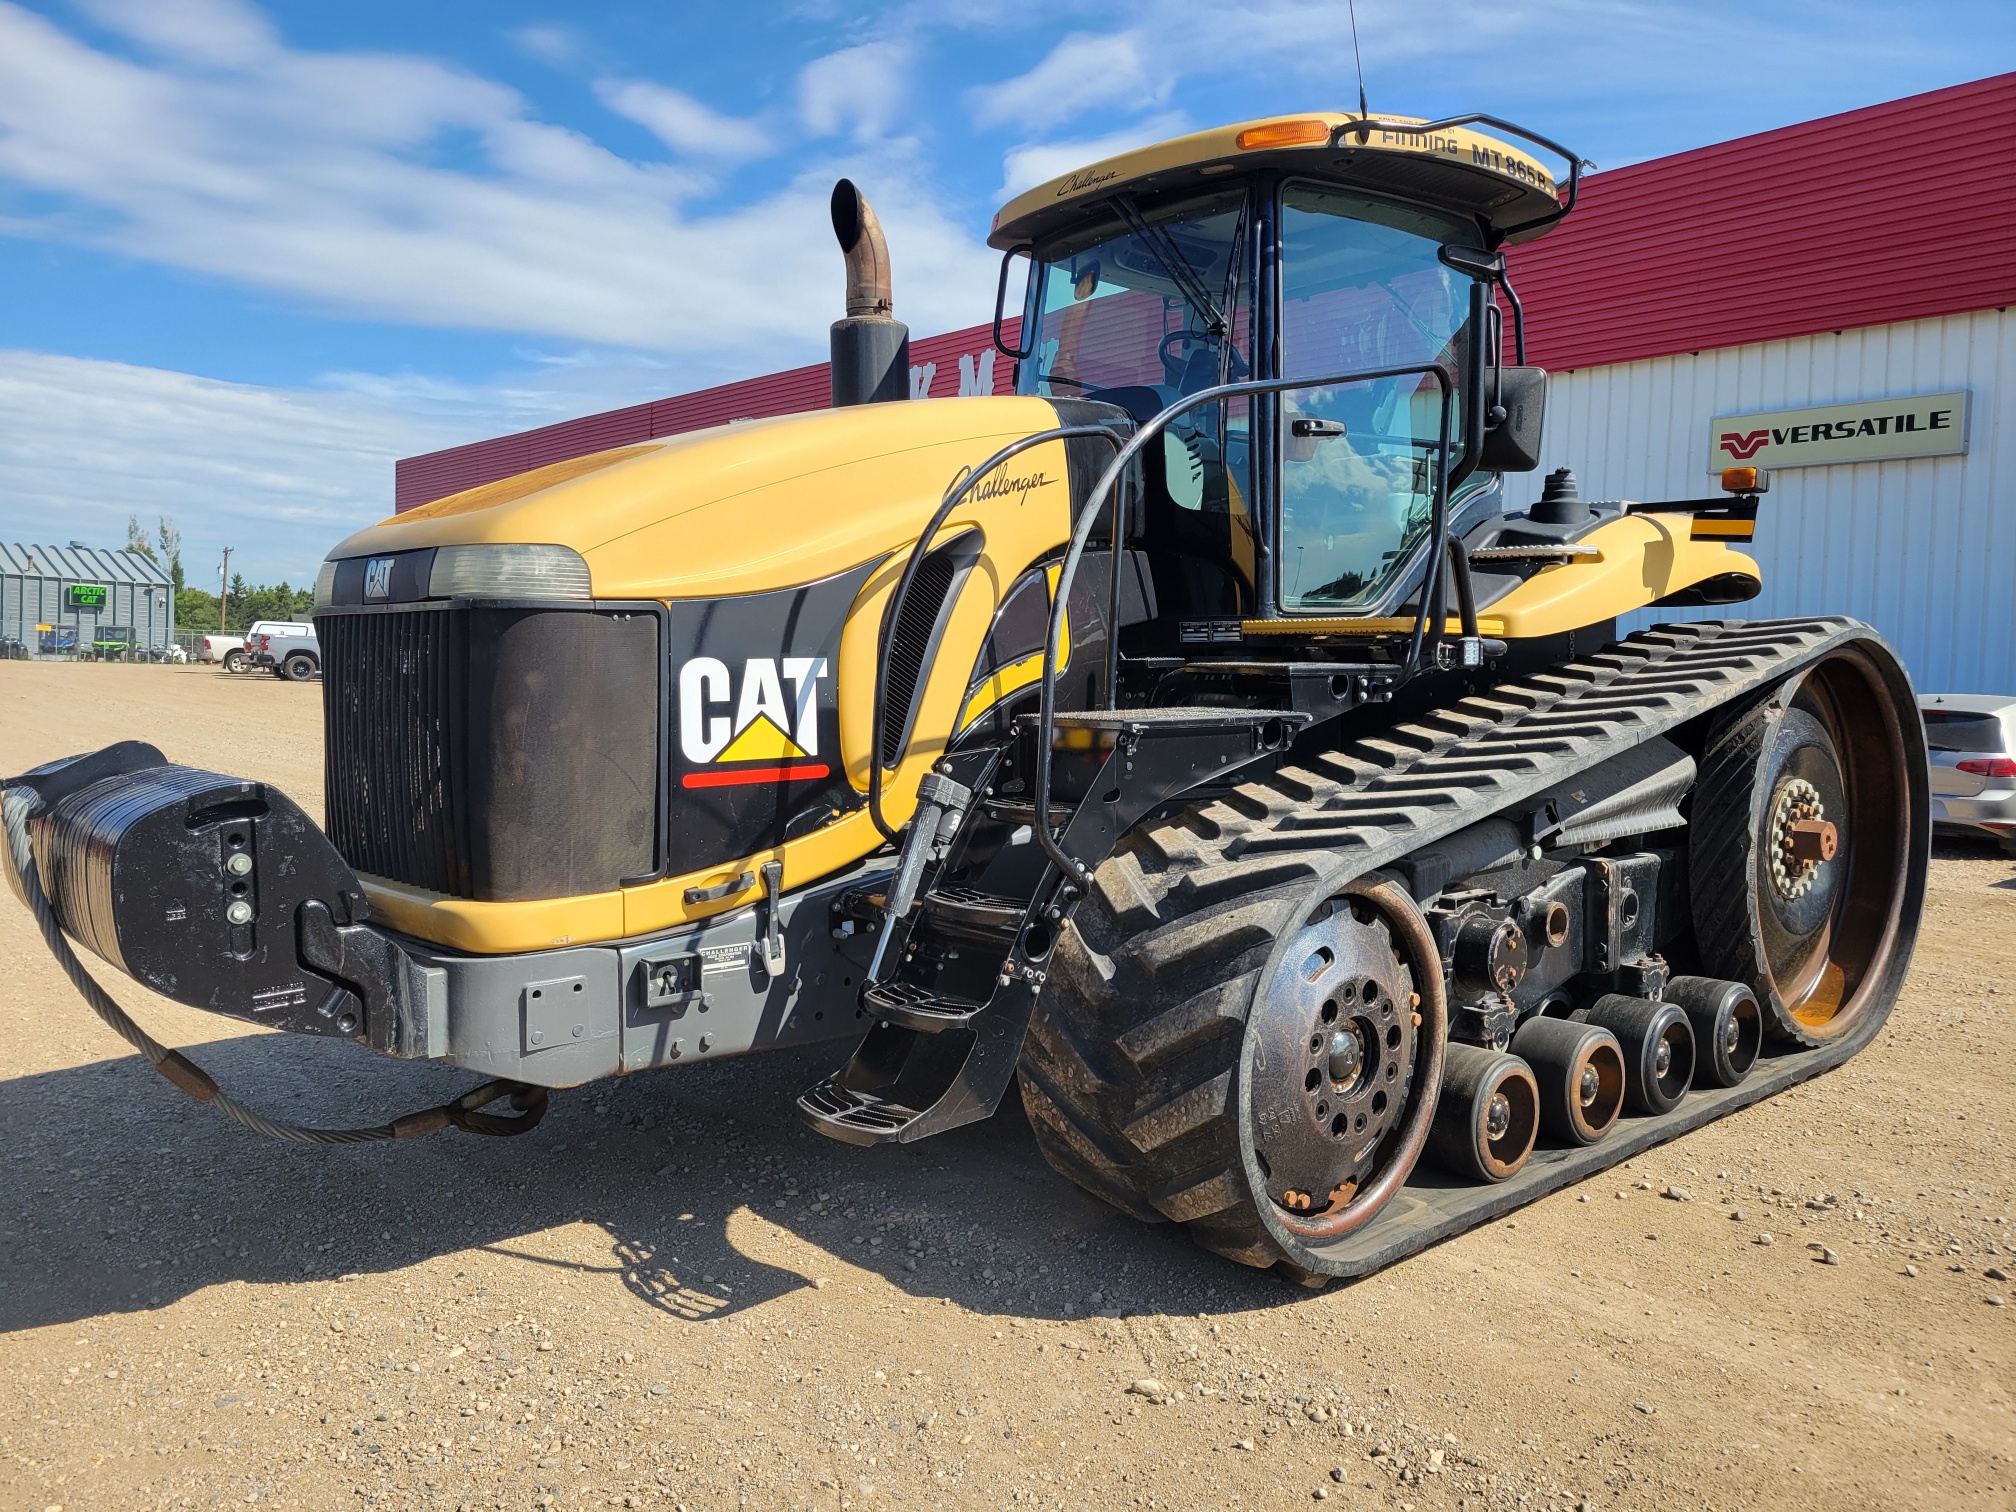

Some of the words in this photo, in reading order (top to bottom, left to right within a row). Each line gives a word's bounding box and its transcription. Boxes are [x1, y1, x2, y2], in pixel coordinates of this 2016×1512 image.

[1057, 170, 1125, 197] Challenger
[1772, 409, 1952, 446] VERSATILE
[942, 462, 1059, 507] Challenger
[73, 586, 105, 596] ARCTIC
[366, 559, 395, 598] CAT
[80, 595, 97, 604] CAT
[680, 656, 828, 764] CAT
[701, 945, 748, 957] CHALLENGER
